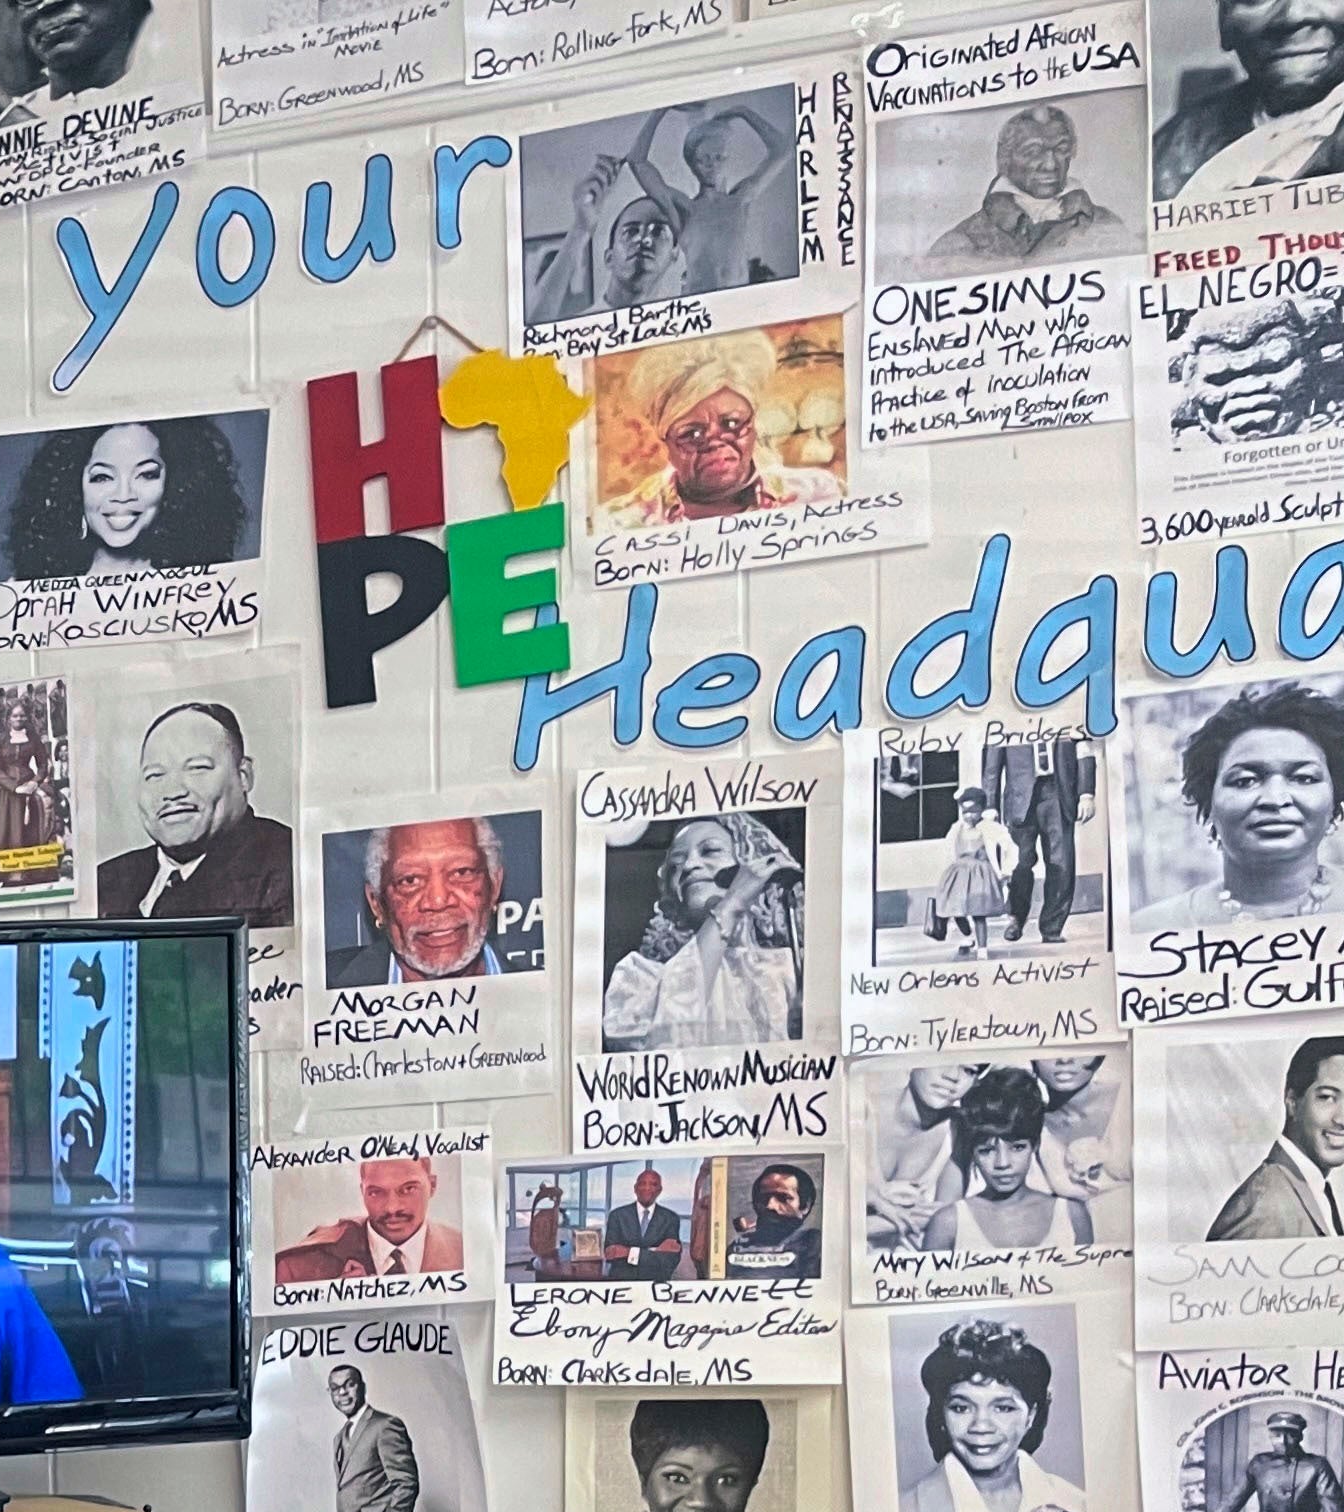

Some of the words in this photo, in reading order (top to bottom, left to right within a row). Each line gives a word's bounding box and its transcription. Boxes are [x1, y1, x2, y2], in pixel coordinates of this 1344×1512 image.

[471, 47, 545, 80] Born:
[683, 4, 722, 29] MS
[1072, 41, 1141, 72] USA
[394, 62, 424, 84] MS
[63, 96, 157, 136] DEVINE
[149, 150, 186, 168] MS
[796, 84, 825, 264] HARLEM
[1153, 194, 1274, 231] HARRIET
[1153, 246, 1241, 278] FREED
[873, 271, 1106, 326] ONESIMUS
[1140, 284, 1198, 320] EL
[1224, 442, 1301, 464] Forgotten
[1306, 437, 1324, 452] or
[1141, 510, 1212, 546] 3,600
[86, 574, 138, 588] QUEEN
[206, 592, 258, 633] MS
[330, 985, 477, 1017] MORGAN
[313, 1011, 481, 1048] FREEMAN
[1054, 1008, 1098, 1038] MS
[761, 1092, 829, 1137] MS
[1148, 1243, 1272, 1285] SAM
[421, 1277, 467, 1294] MS
[510, 1285, 633, 1307] LERONE
[1019, 1274, 1054, 1295] MS
[261, 1327, 346, 1365] EDDIE
[703, 1358, 753, 1383] MS
